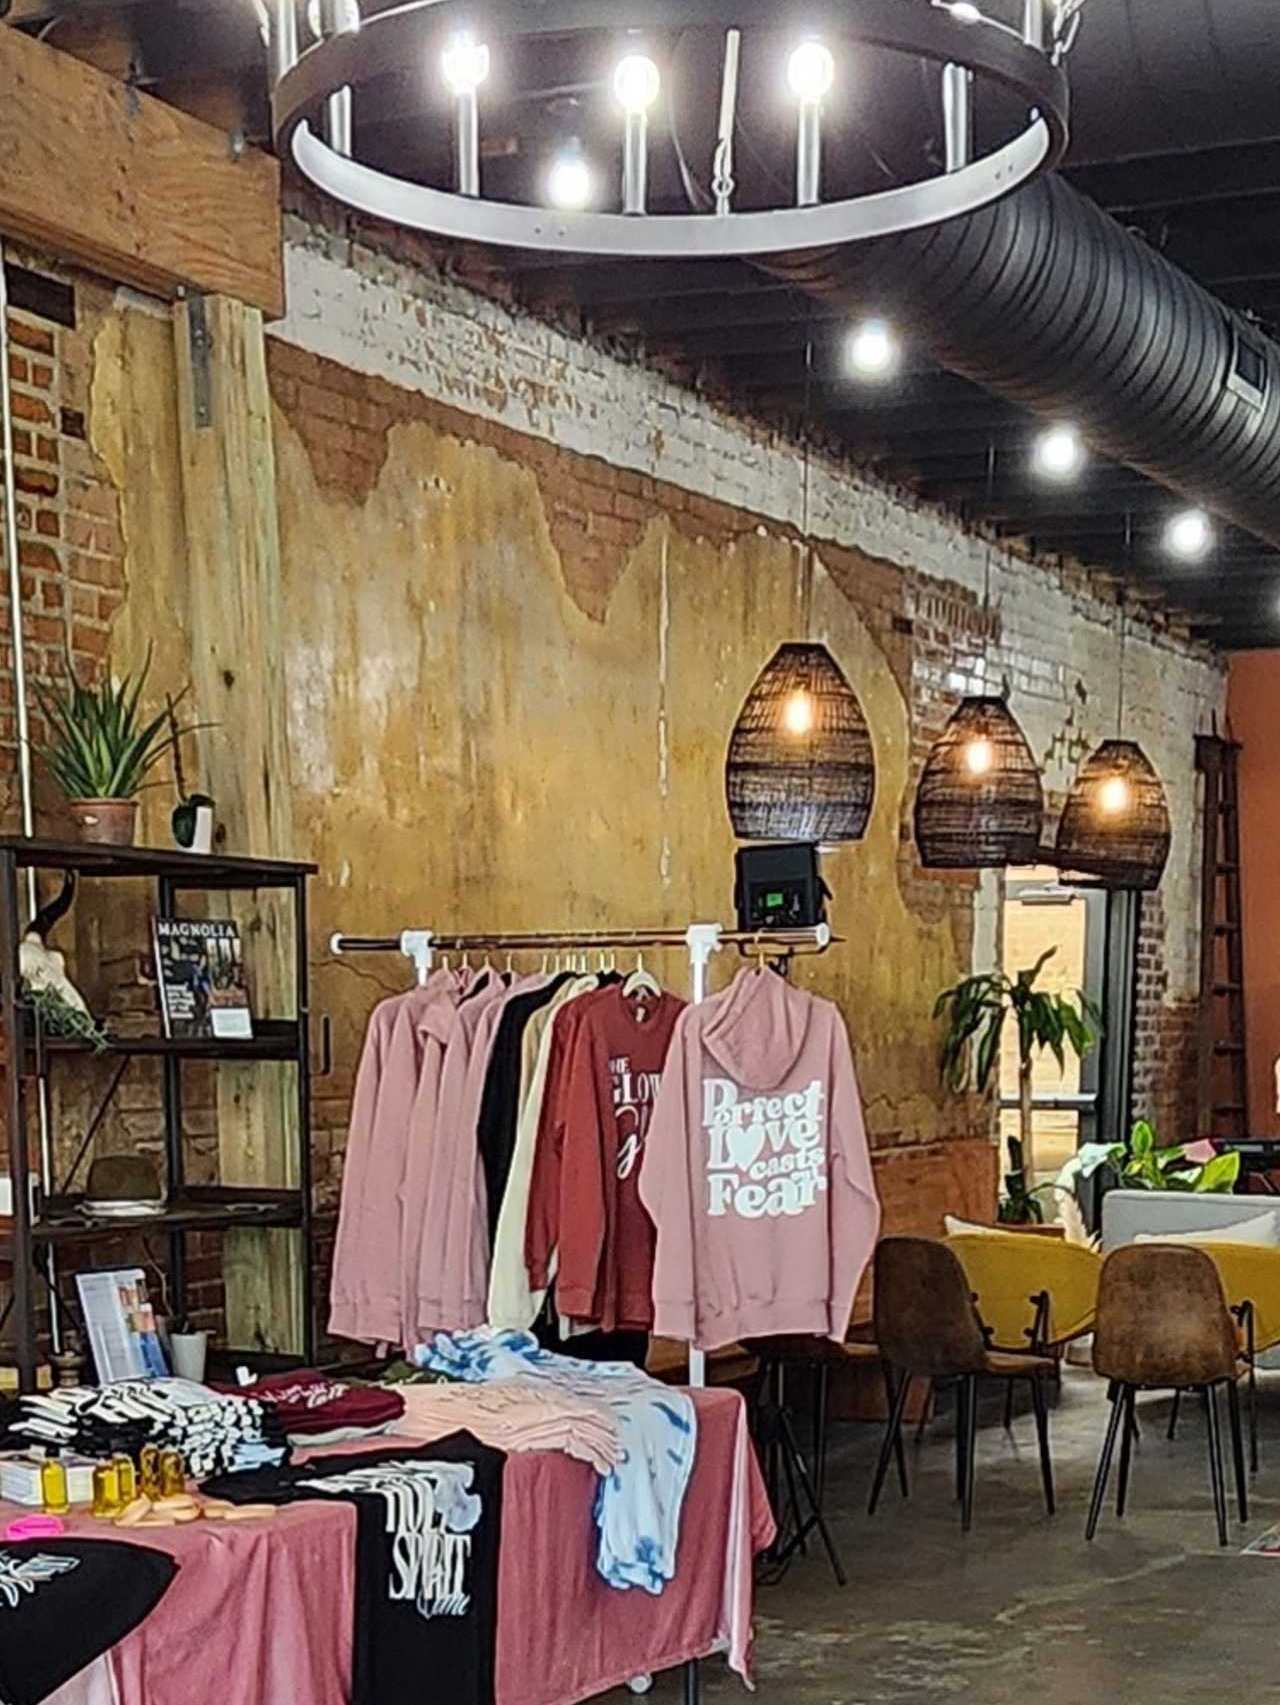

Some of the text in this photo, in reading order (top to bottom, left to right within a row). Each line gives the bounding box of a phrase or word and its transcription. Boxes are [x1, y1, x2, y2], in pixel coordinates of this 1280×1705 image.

[158, 922, 235, 936] MAGNOLIA
[702, 1077, 825, 1127] Perfect
[749, 1147, 825, 1181] casts
[707, 1169, 827, 1219] Fear
